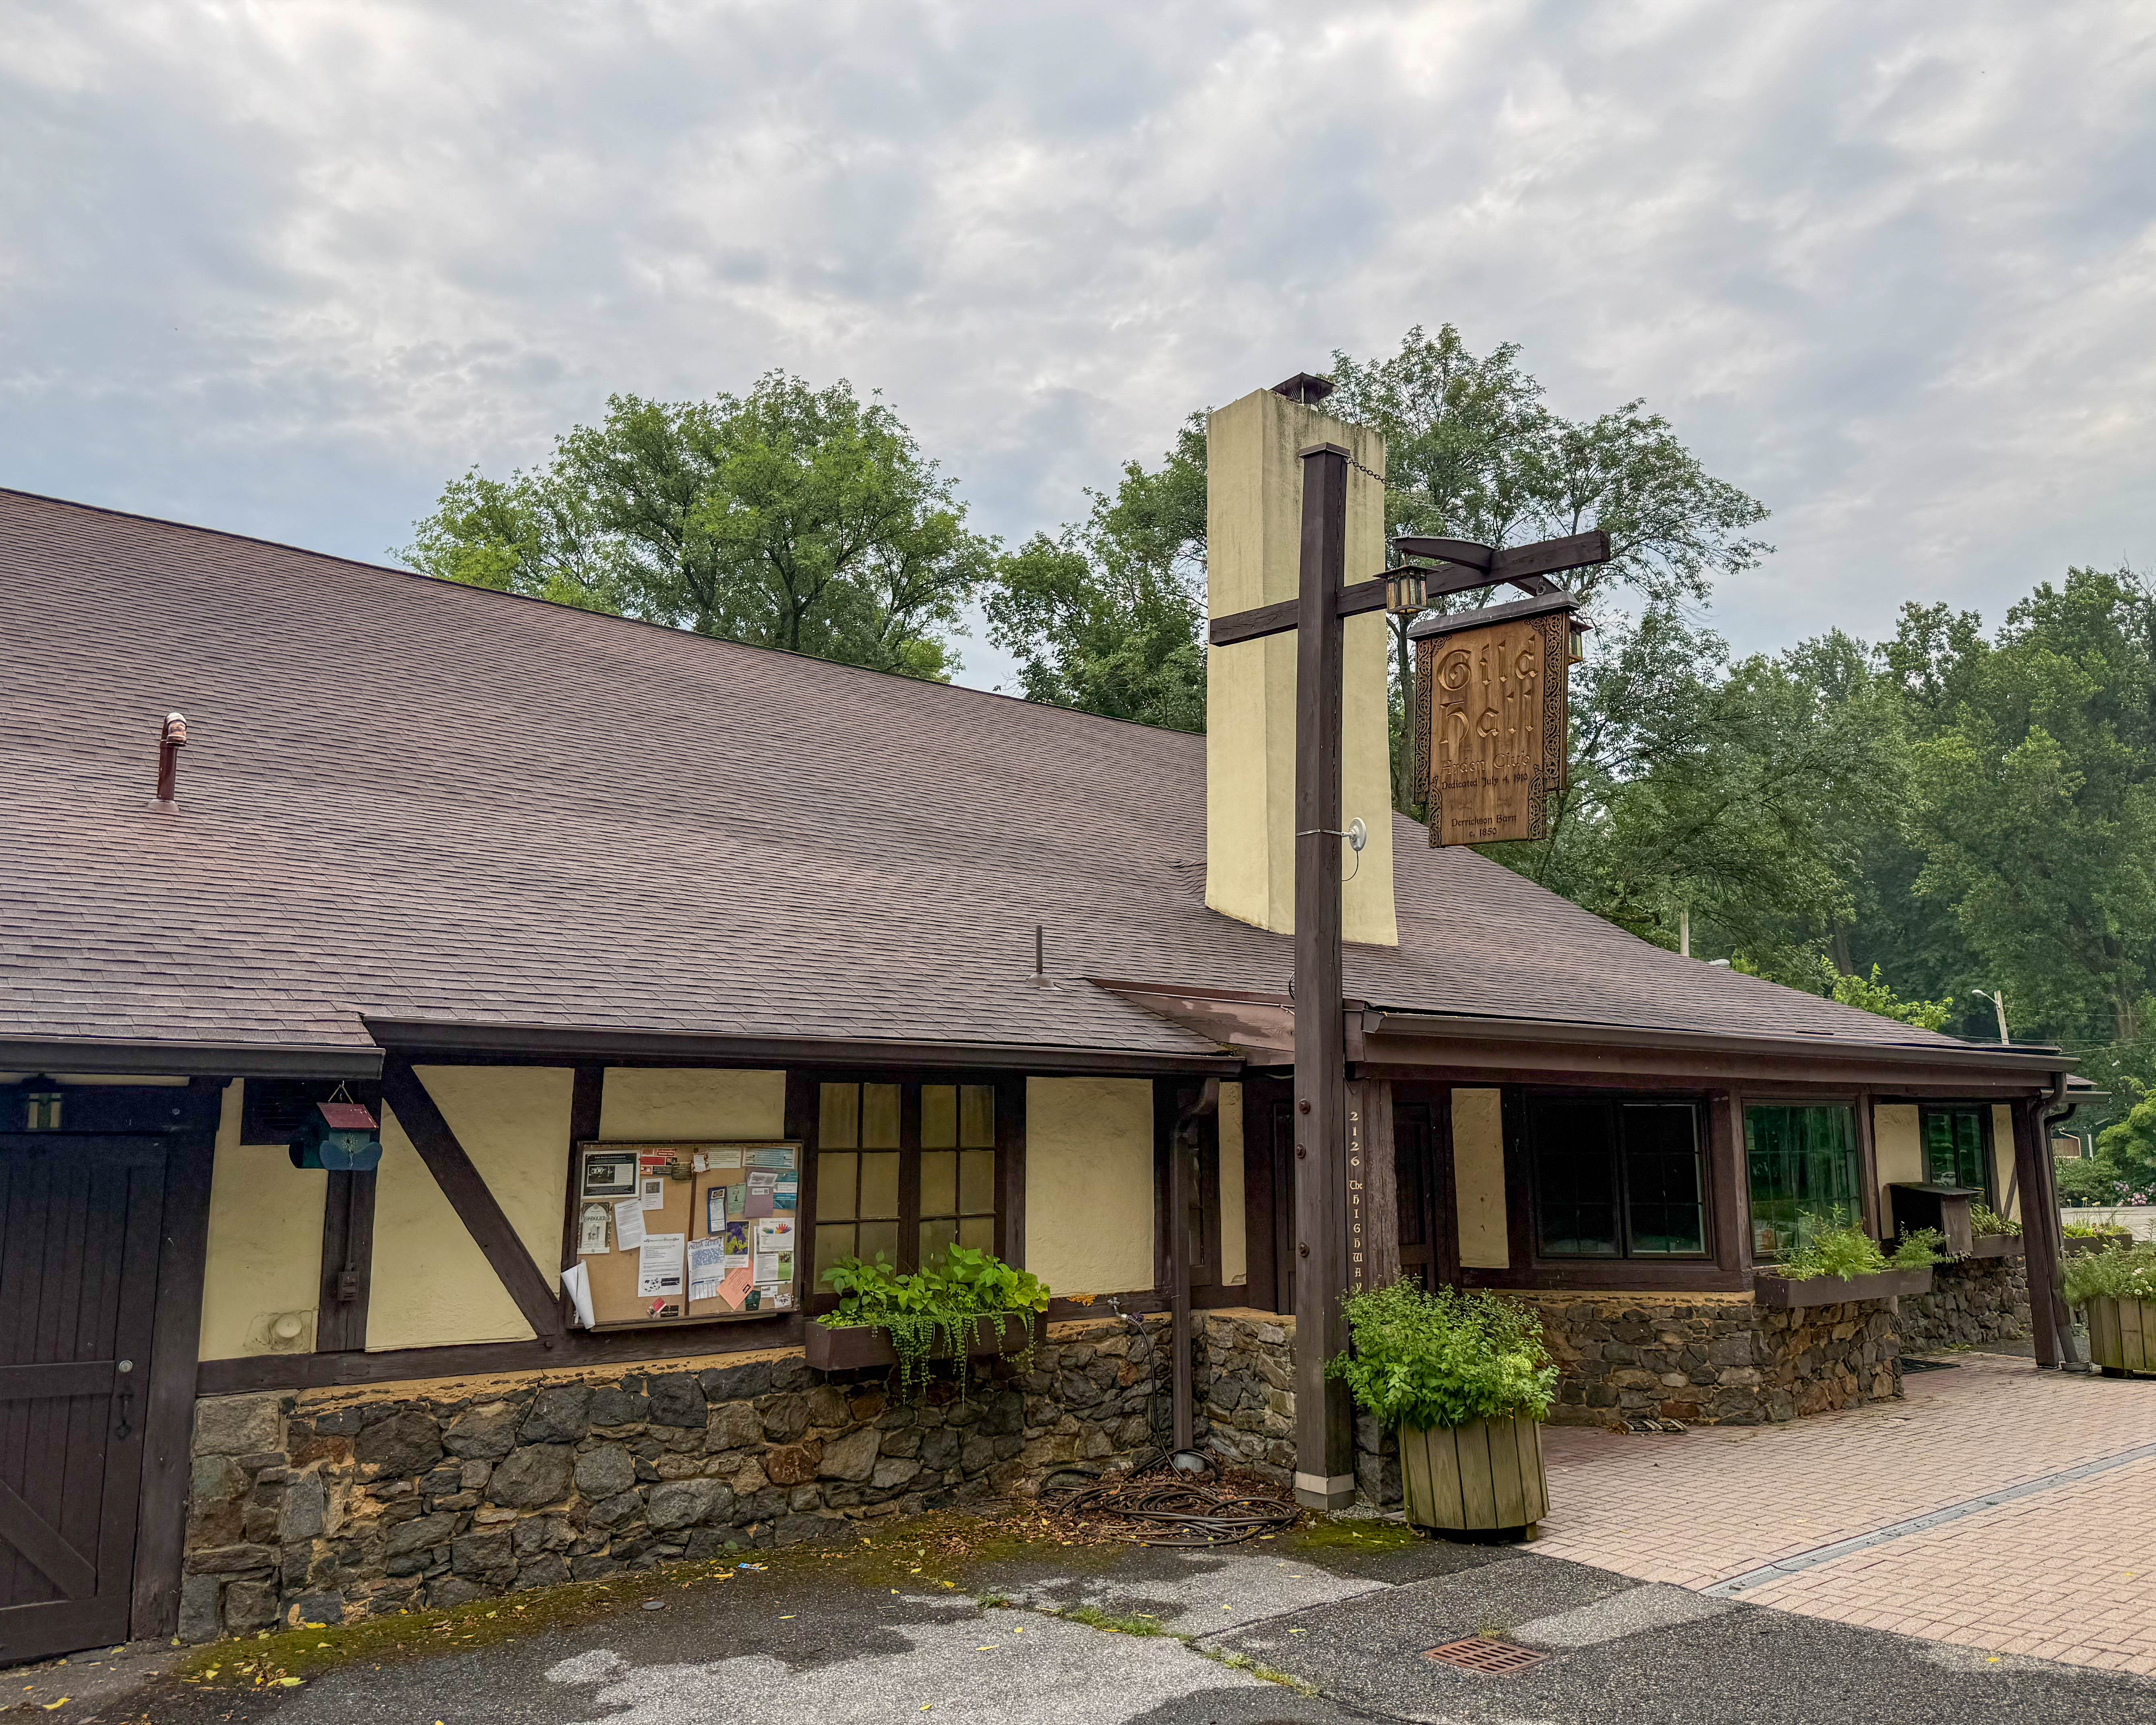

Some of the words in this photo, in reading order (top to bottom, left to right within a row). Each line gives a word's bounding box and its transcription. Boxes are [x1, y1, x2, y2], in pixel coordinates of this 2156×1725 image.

[1437, 635, 1538, 691] Gild
[1440, 757, 1485, 776] Arden
[1493, 751, 1530, 769] Club
[1442, 778, 1477, 790] Dedicated
[1482, 776, 1499, 788] July
[1514, 772, 1528, 782] 1910
[1451, 816, 1492, 827] Derrickson
[1496, 814, 1516, 824] Barn
[1480, 827, 1497, 837] 1850
[1350, 1111, 1360, 1166] 2126
[1349, 1180, 1363, 1190] The
